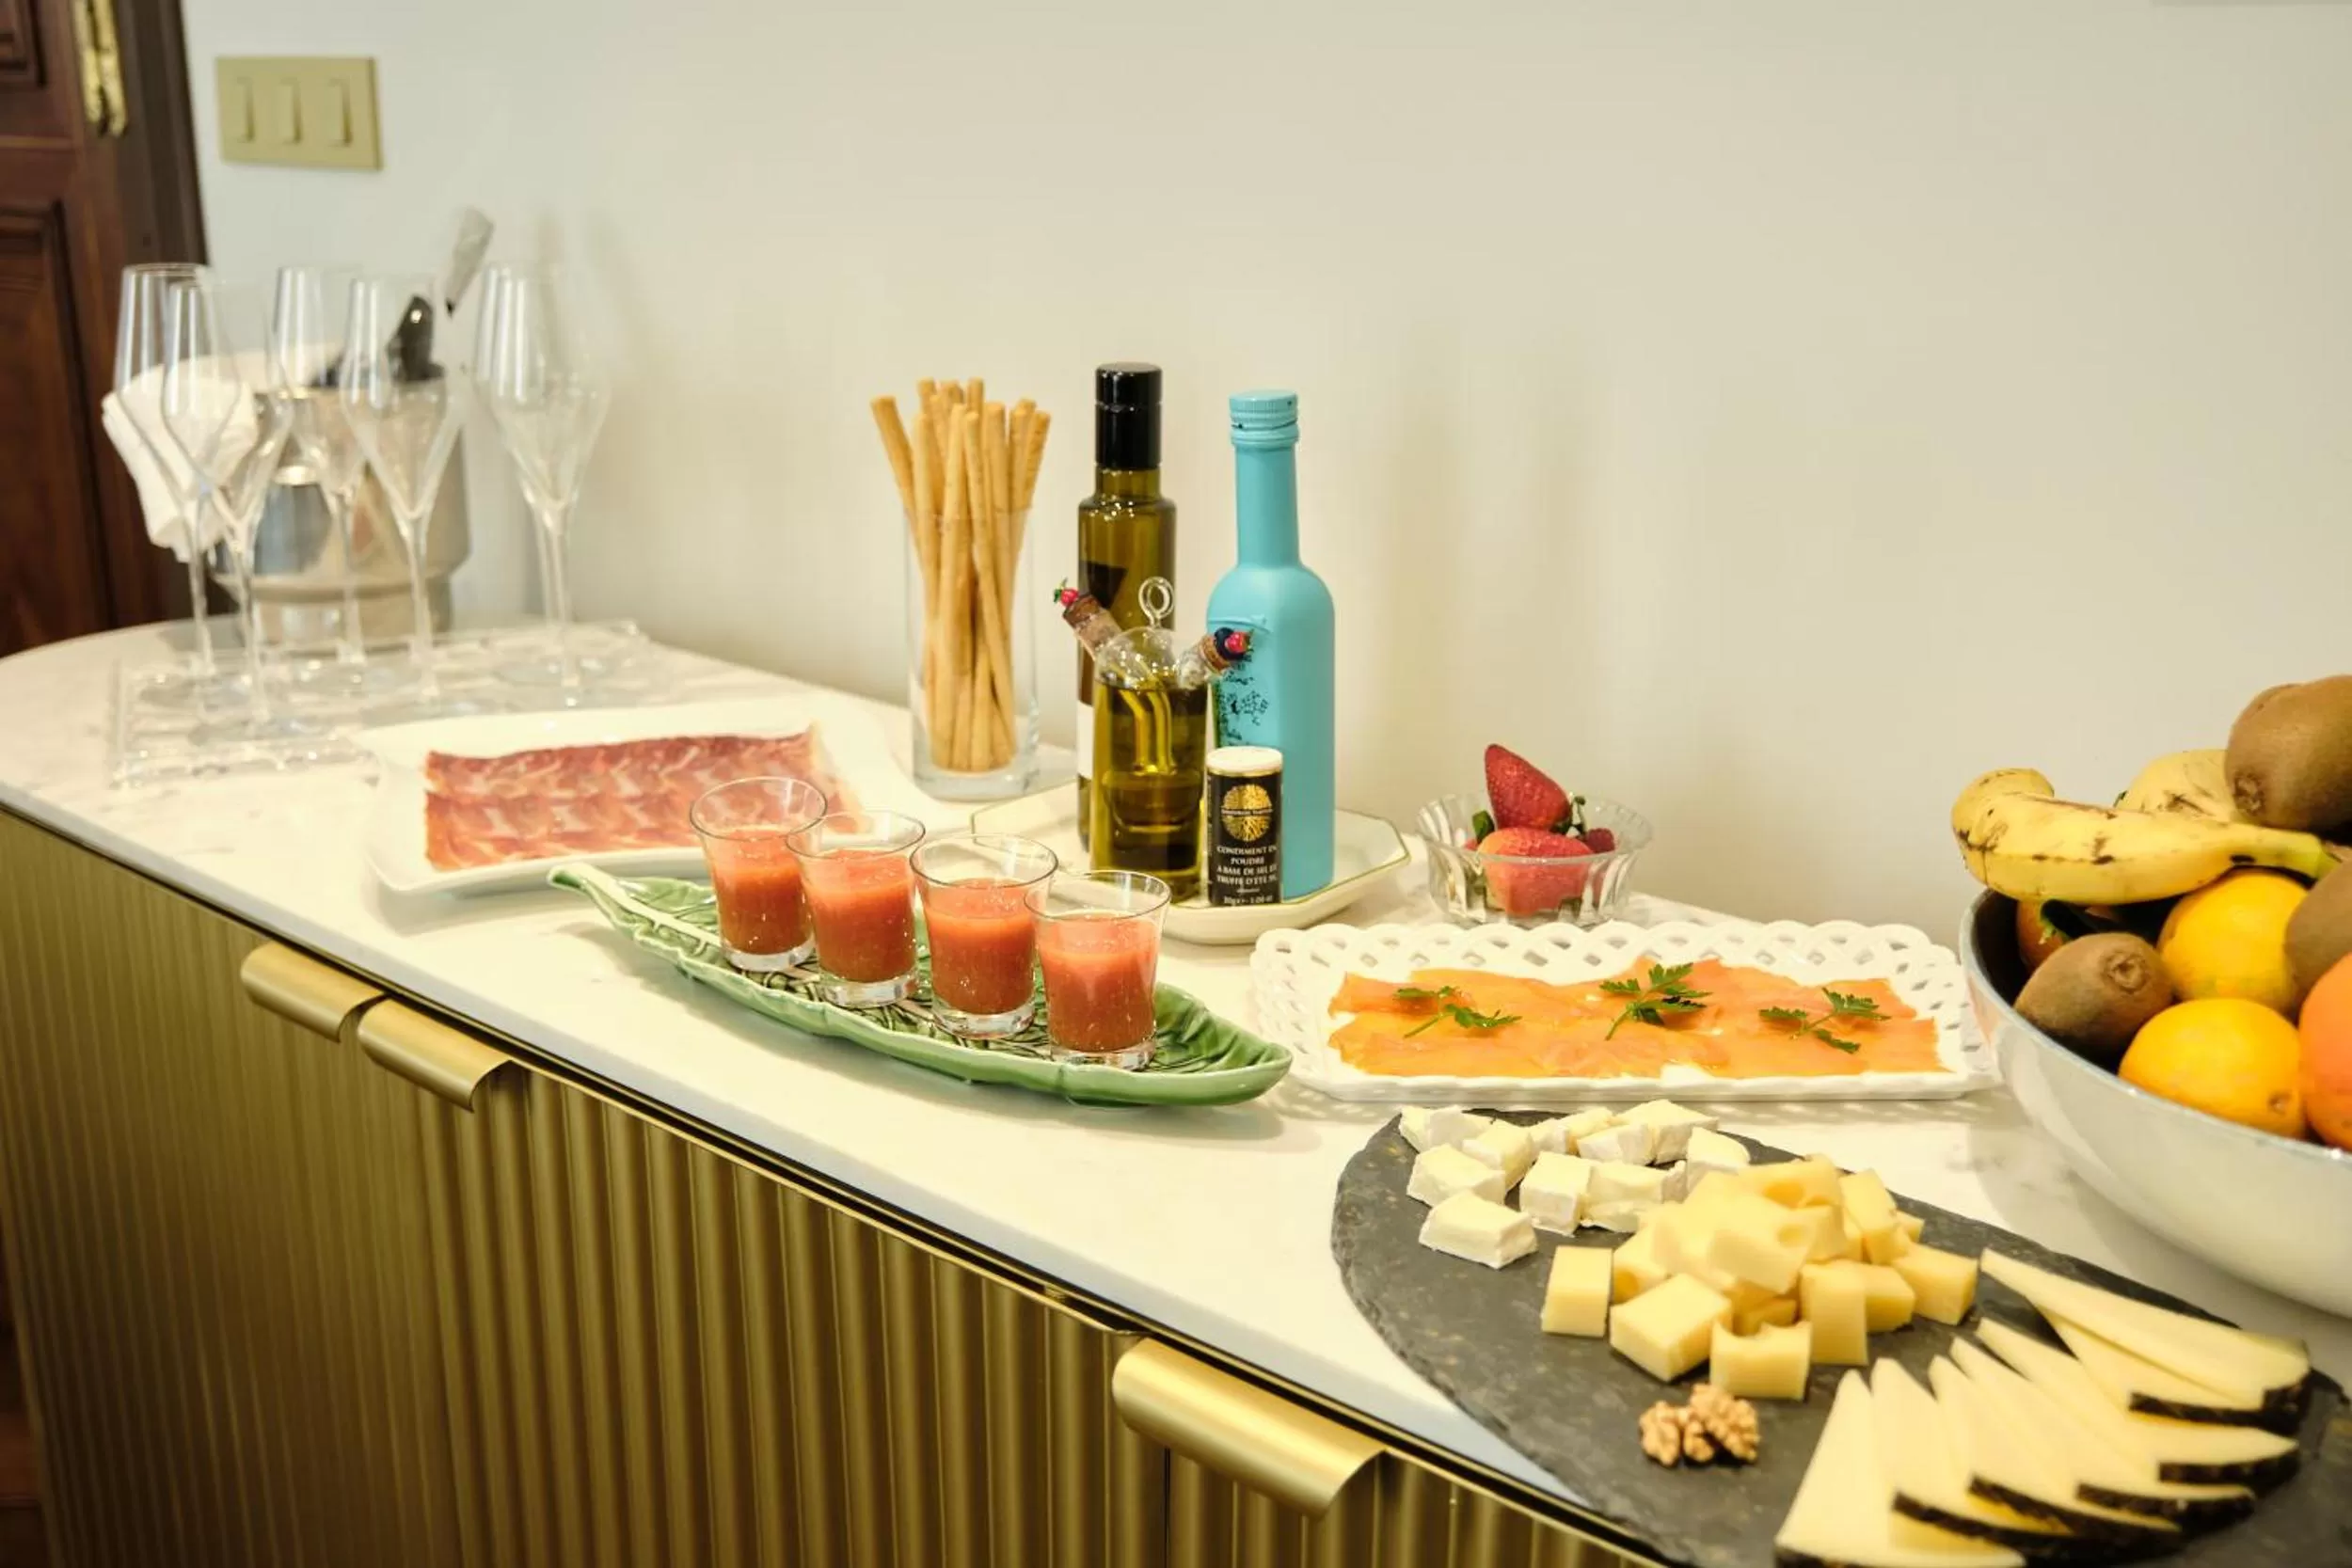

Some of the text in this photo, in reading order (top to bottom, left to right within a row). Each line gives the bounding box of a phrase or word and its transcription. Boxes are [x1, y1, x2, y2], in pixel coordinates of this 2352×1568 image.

[1216, 846, 1266, 854] CONDIMENT
[1223, 866, 1242, 876] BASE
[1243, 867, 1255, 876] DE
